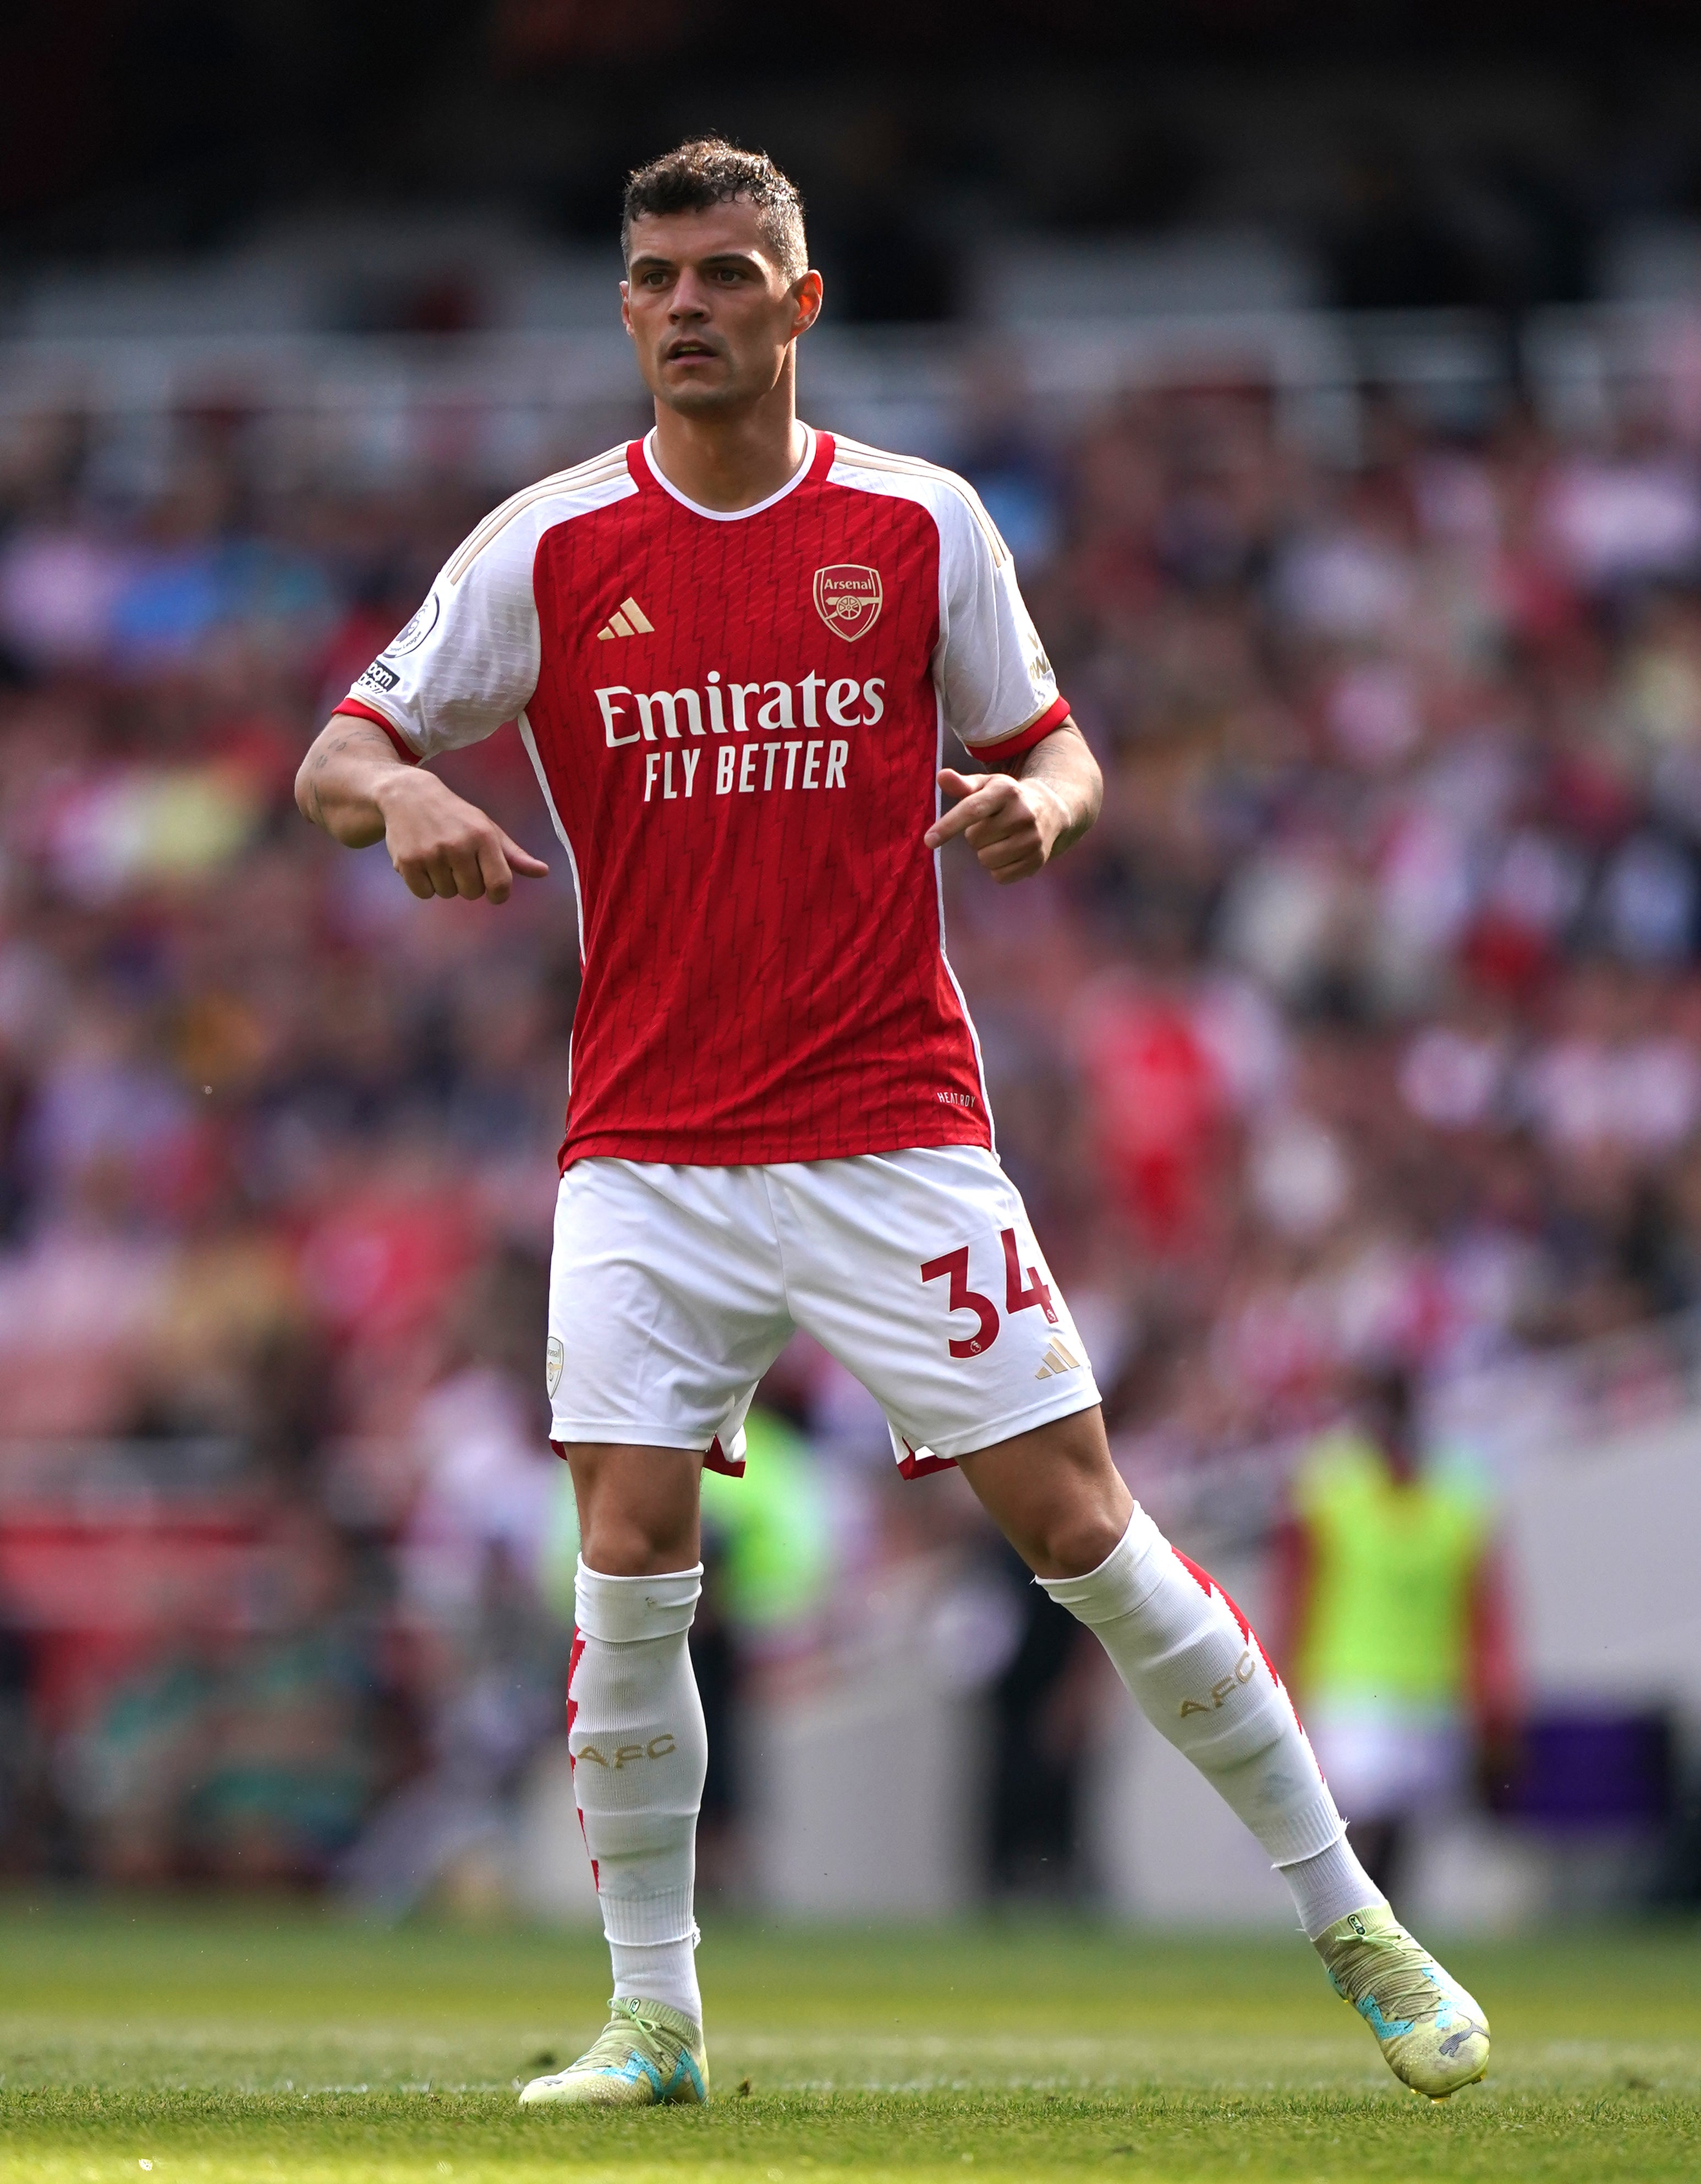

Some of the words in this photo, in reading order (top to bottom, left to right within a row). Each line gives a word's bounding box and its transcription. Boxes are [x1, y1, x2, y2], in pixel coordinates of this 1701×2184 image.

[824, 578, 872, 590] Arsenal
[594, 669, 885, 747] Emirates
[644, 749, 700, 802] FLY
[715, 740, 848, 795] BETTER
[937, 1092, 975, 1108] HEAT.RDY
[920, 1227, 1059, 1359] 34
[1181, 1650, 1255, 1718] AFC
[577, 1733, 676, 1769] AFC
